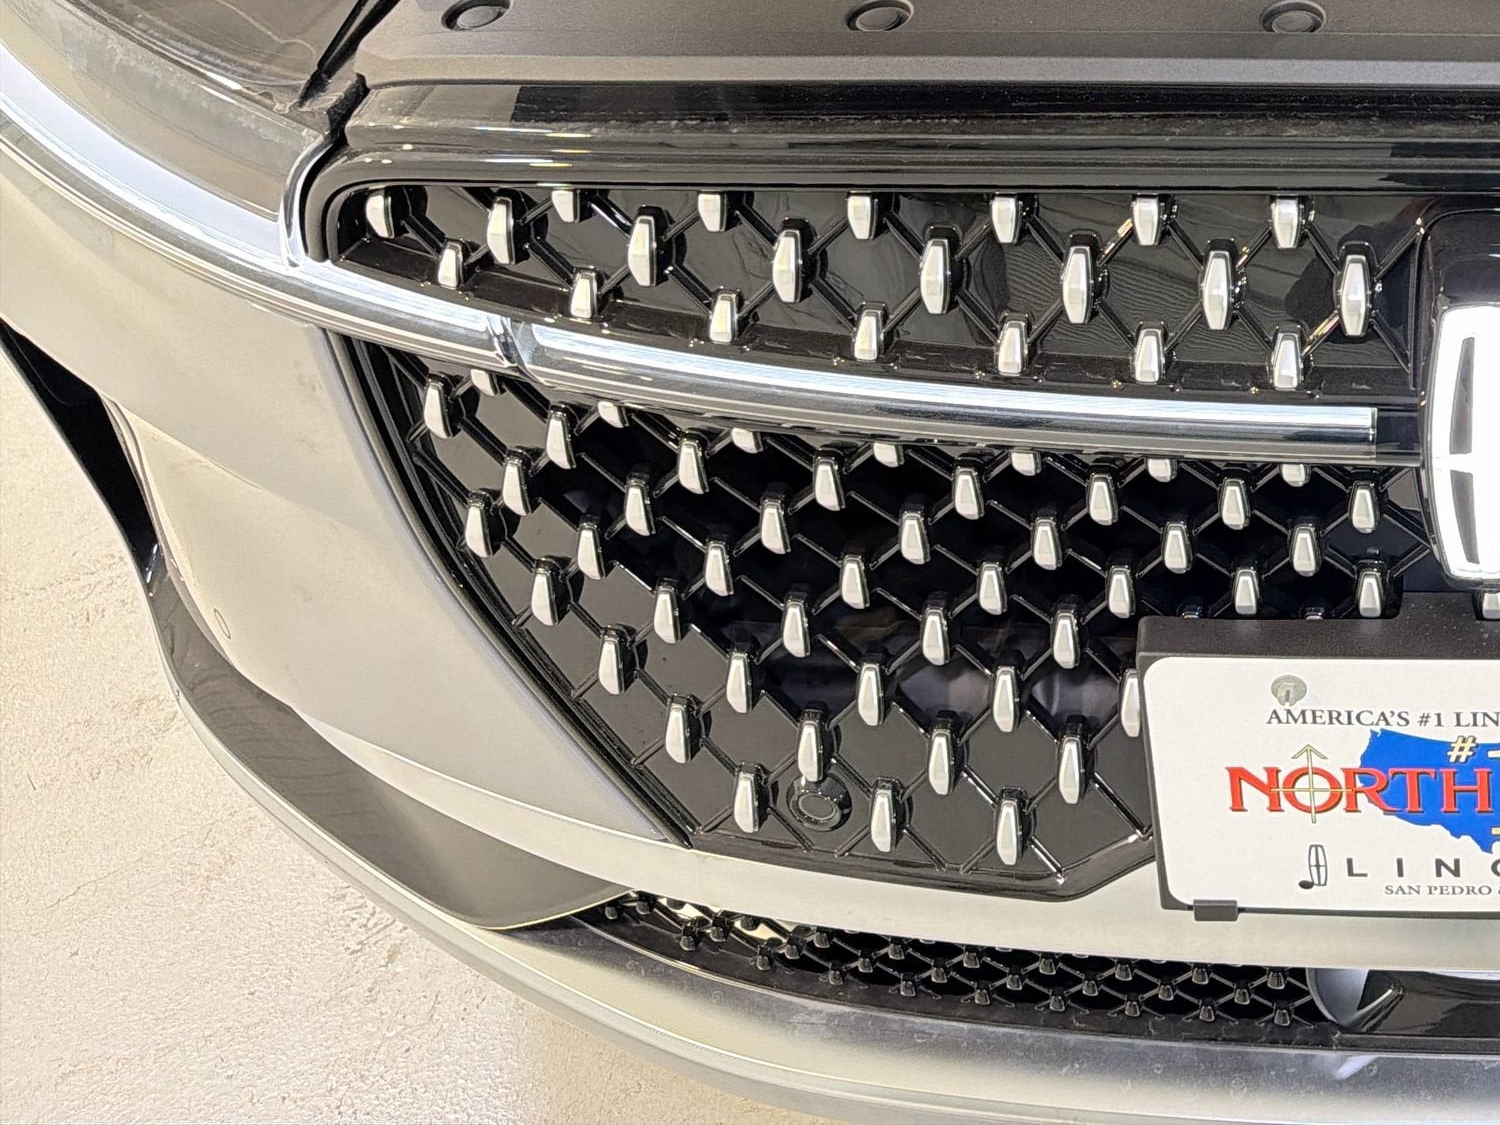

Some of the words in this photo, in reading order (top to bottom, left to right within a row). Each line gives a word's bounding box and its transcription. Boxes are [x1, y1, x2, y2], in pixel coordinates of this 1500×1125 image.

[1266, 708, 1410, 727] AMERICA'S
[1417, 711, 1445, 727] #1
[1225, 766, 1494, 814] NORTH
[1384, 884, 1421, 895] SAN
[1427, 884, 1492, 896] PEDRO
